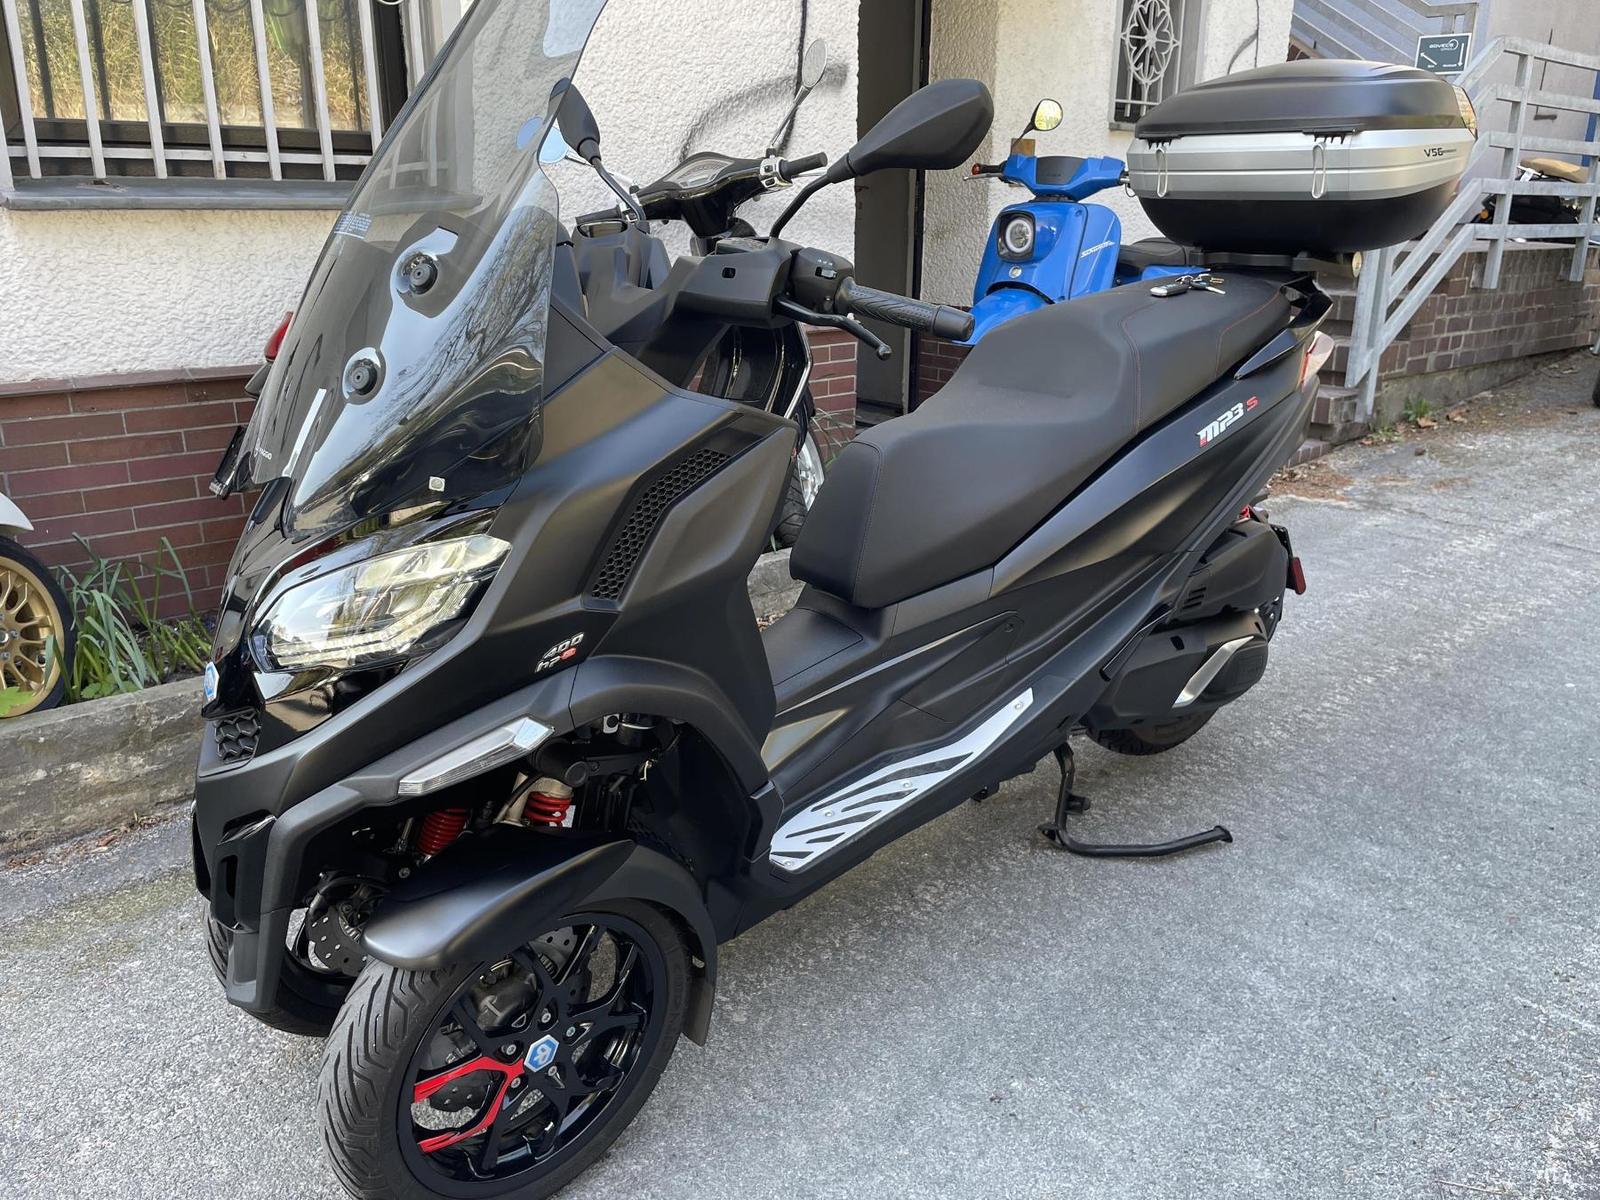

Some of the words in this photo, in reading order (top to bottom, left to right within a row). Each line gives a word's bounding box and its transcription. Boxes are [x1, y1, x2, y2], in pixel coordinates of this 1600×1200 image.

[1197, 402, 1244, 447] MP3
[1246, 396, 1259, 411] S
[543, 632, 584, 660] 400
